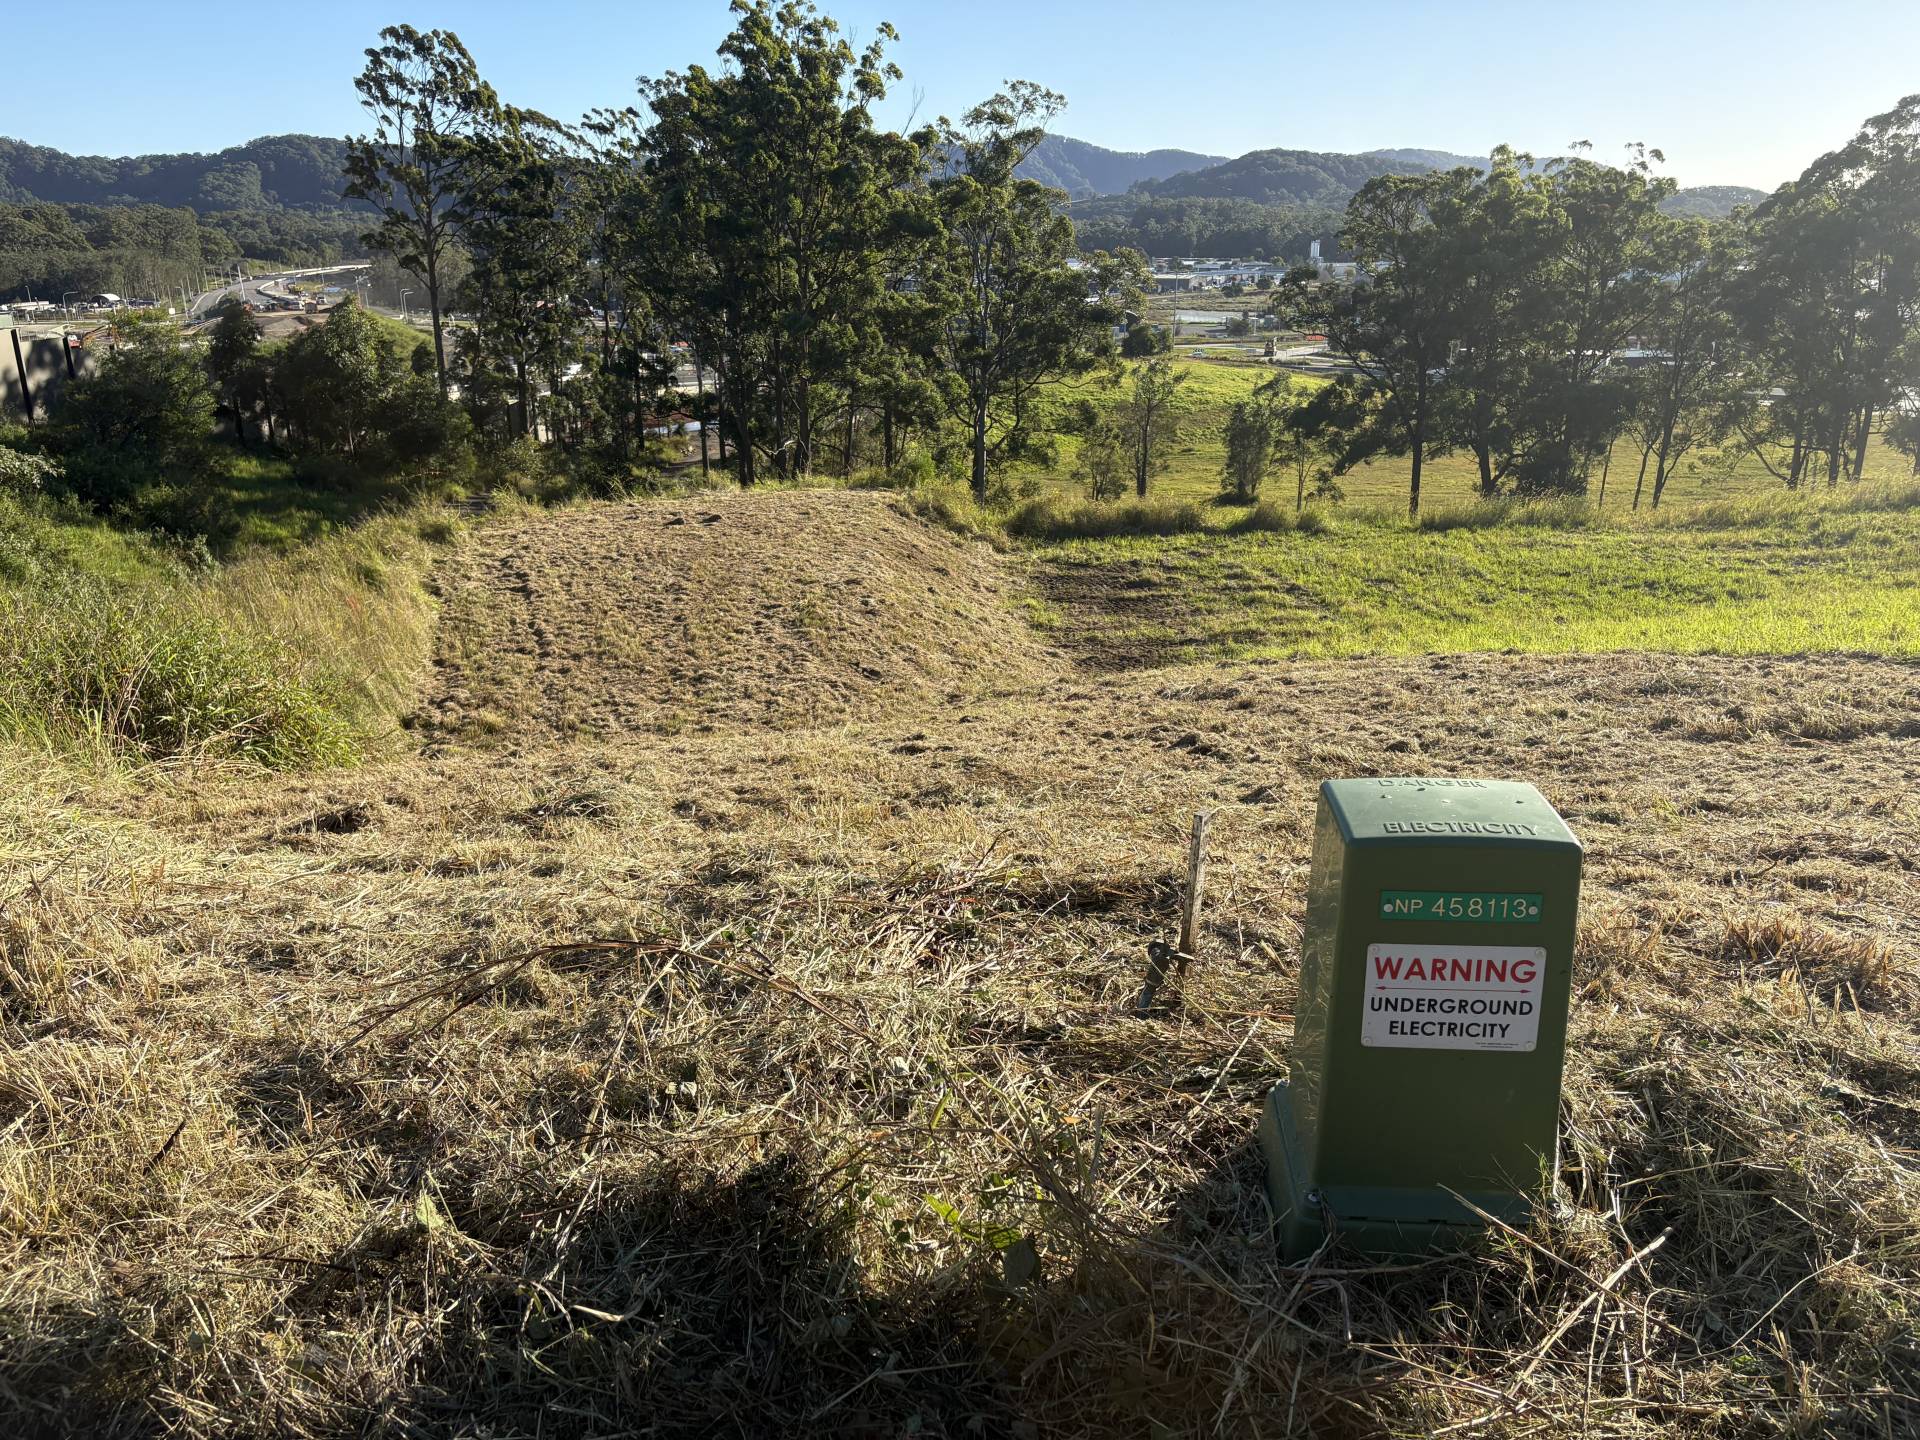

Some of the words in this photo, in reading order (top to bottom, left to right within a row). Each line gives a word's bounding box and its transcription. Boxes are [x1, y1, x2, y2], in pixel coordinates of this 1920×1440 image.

[1378, 779, 1487, 788] DANGER
[1383, 821, 1538, 836] ELECTRICITY
[1395, 899, 1423, 913] NP
[1431, 898, 1527, 918] 458113
[1374, 957, 1537, 984] WARNING
[1370, 997, 1533, 1016] UNDERGROUND
[1388, 1021, 1511, 1039] ELECTRICITY
